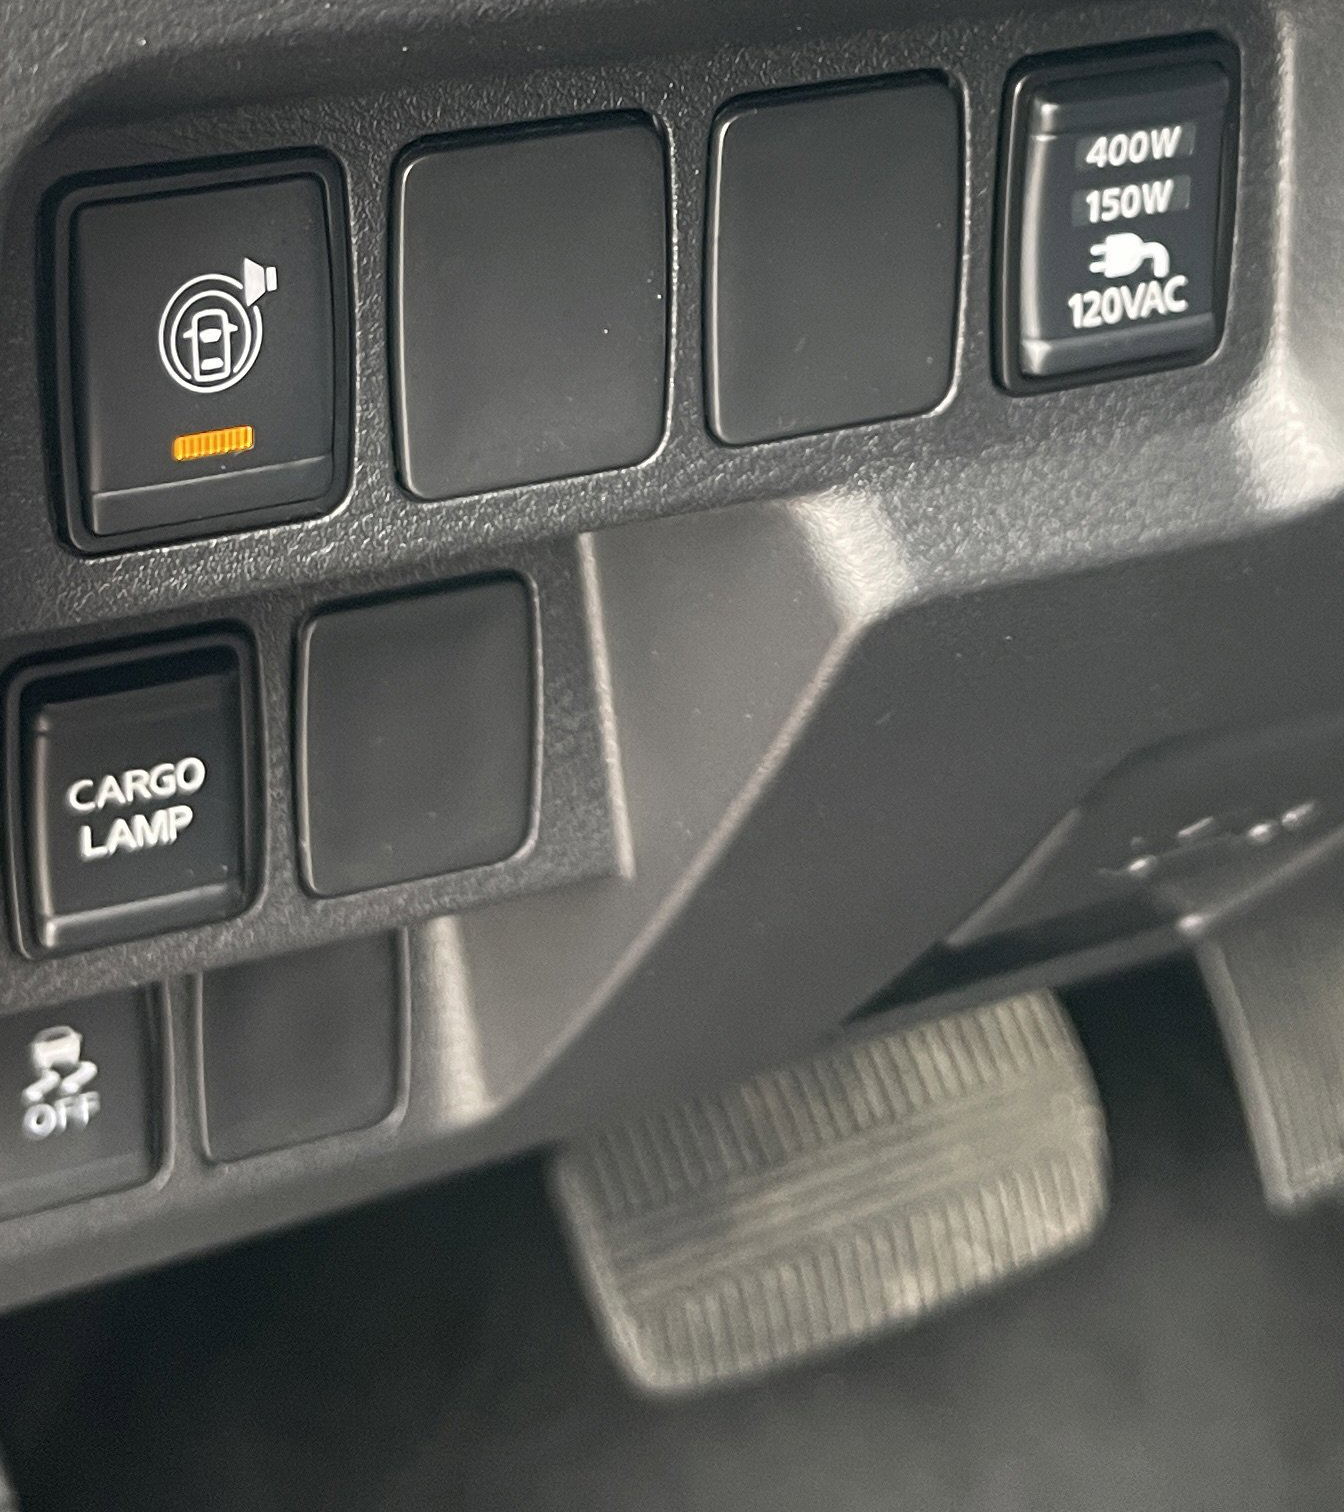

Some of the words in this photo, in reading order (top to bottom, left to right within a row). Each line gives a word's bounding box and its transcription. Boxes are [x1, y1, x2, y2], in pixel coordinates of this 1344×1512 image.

[1085, 125, 1182, 168] 400W
[1085, 178, 1174, 224] 150W
[1067, 274, 1189, 329] 120VAC
[65, 756, 206, 815] CARGO
[79, 804, 194, 862] LAMP
[21, 1091, 101, 1140] OFF
